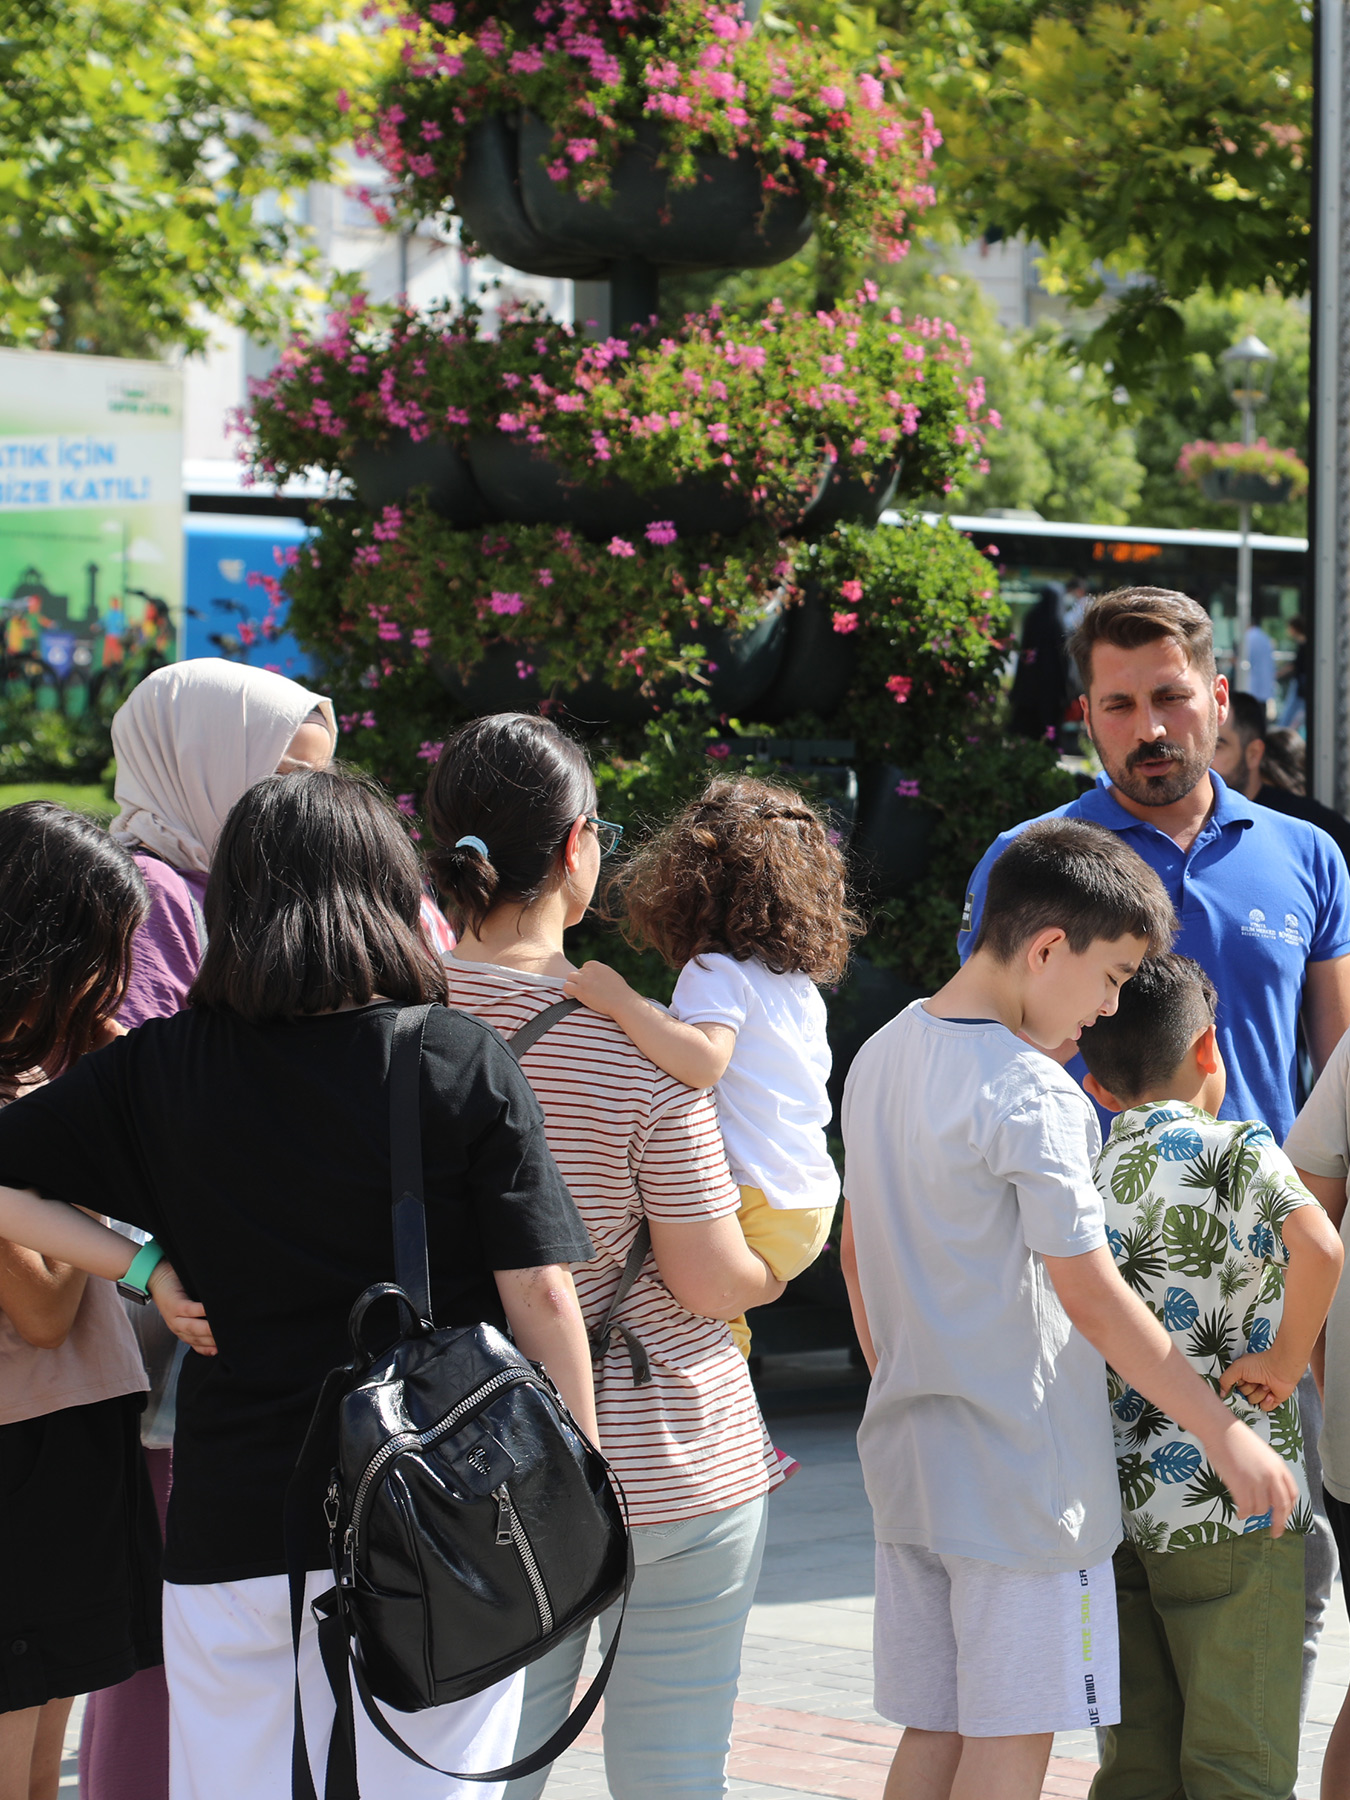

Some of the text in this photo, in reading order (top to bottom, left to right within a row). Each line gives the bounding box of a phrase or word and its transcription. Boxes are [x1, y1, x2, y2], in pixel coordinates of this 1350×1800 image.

[0, 435, 118, 471] TIK İÇİN
[60, 475, 151, 502] KATIL!
[1081, 1590, 1091, 1624] SOUL
[1084, 1673, 1096, 1704] MIND
